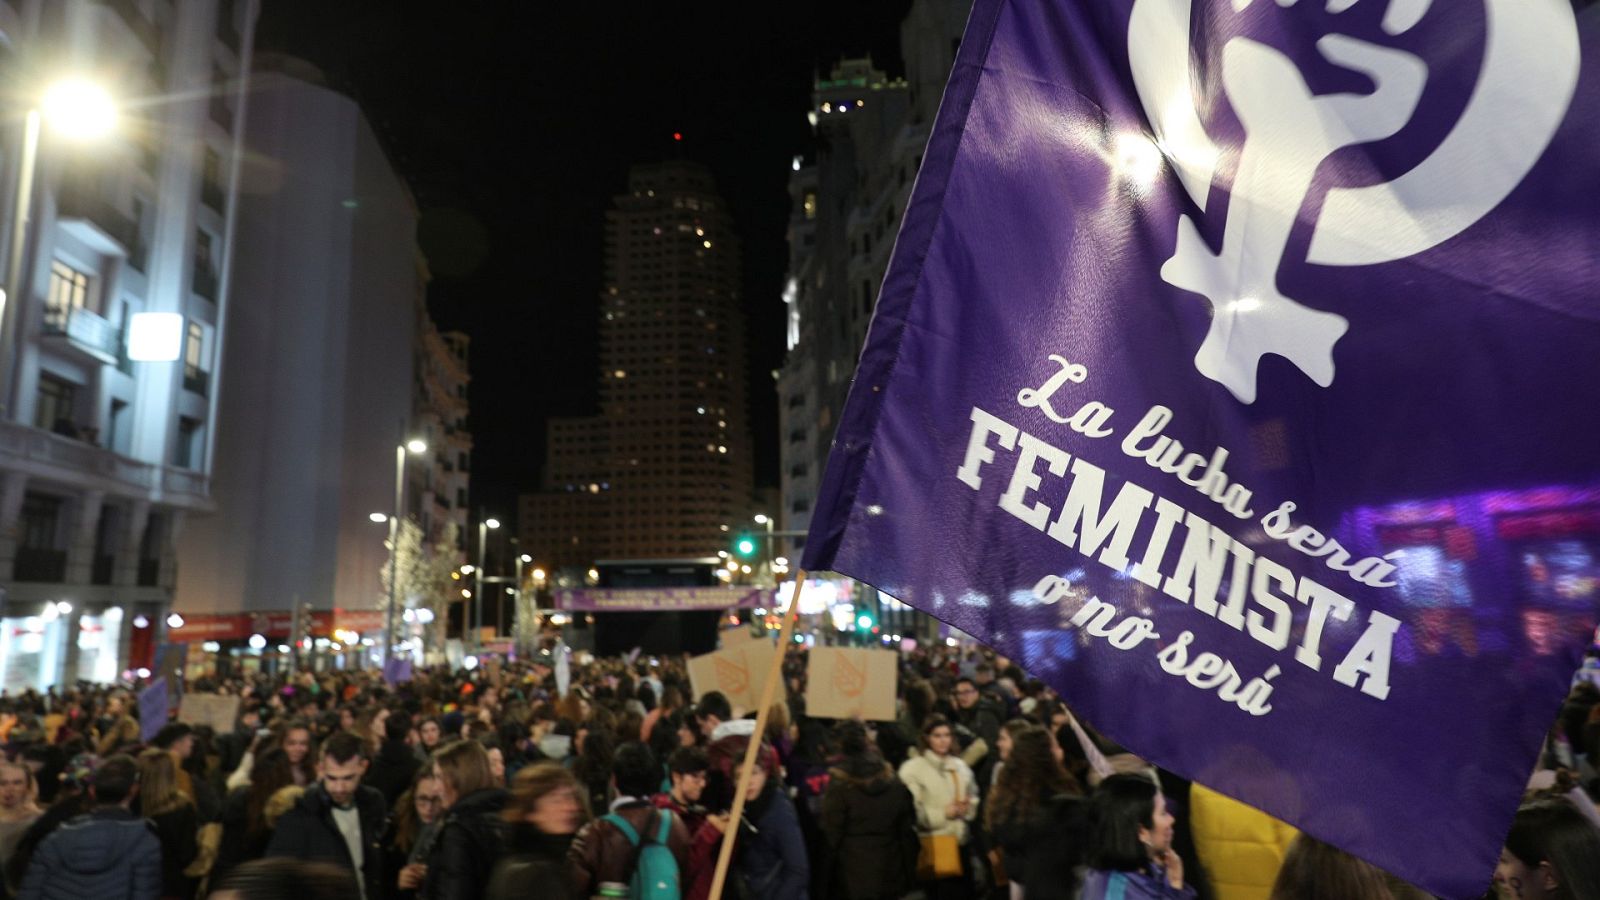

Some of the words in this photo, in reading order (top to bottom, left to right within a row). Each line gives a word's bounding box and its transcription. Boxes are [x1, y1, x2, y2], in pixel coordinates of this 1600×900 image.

[957, 407, 1402, 700] FEMINISTA
[1017, 354, 1114, 438] La
[1121, 405, 1254, 519] lucha
[1261, 500, 1398, 588] será
[1033, 574, 1073, 605] o
[1072, 595, 1160, 651] no
[1157, 630, 1274, 716] será
